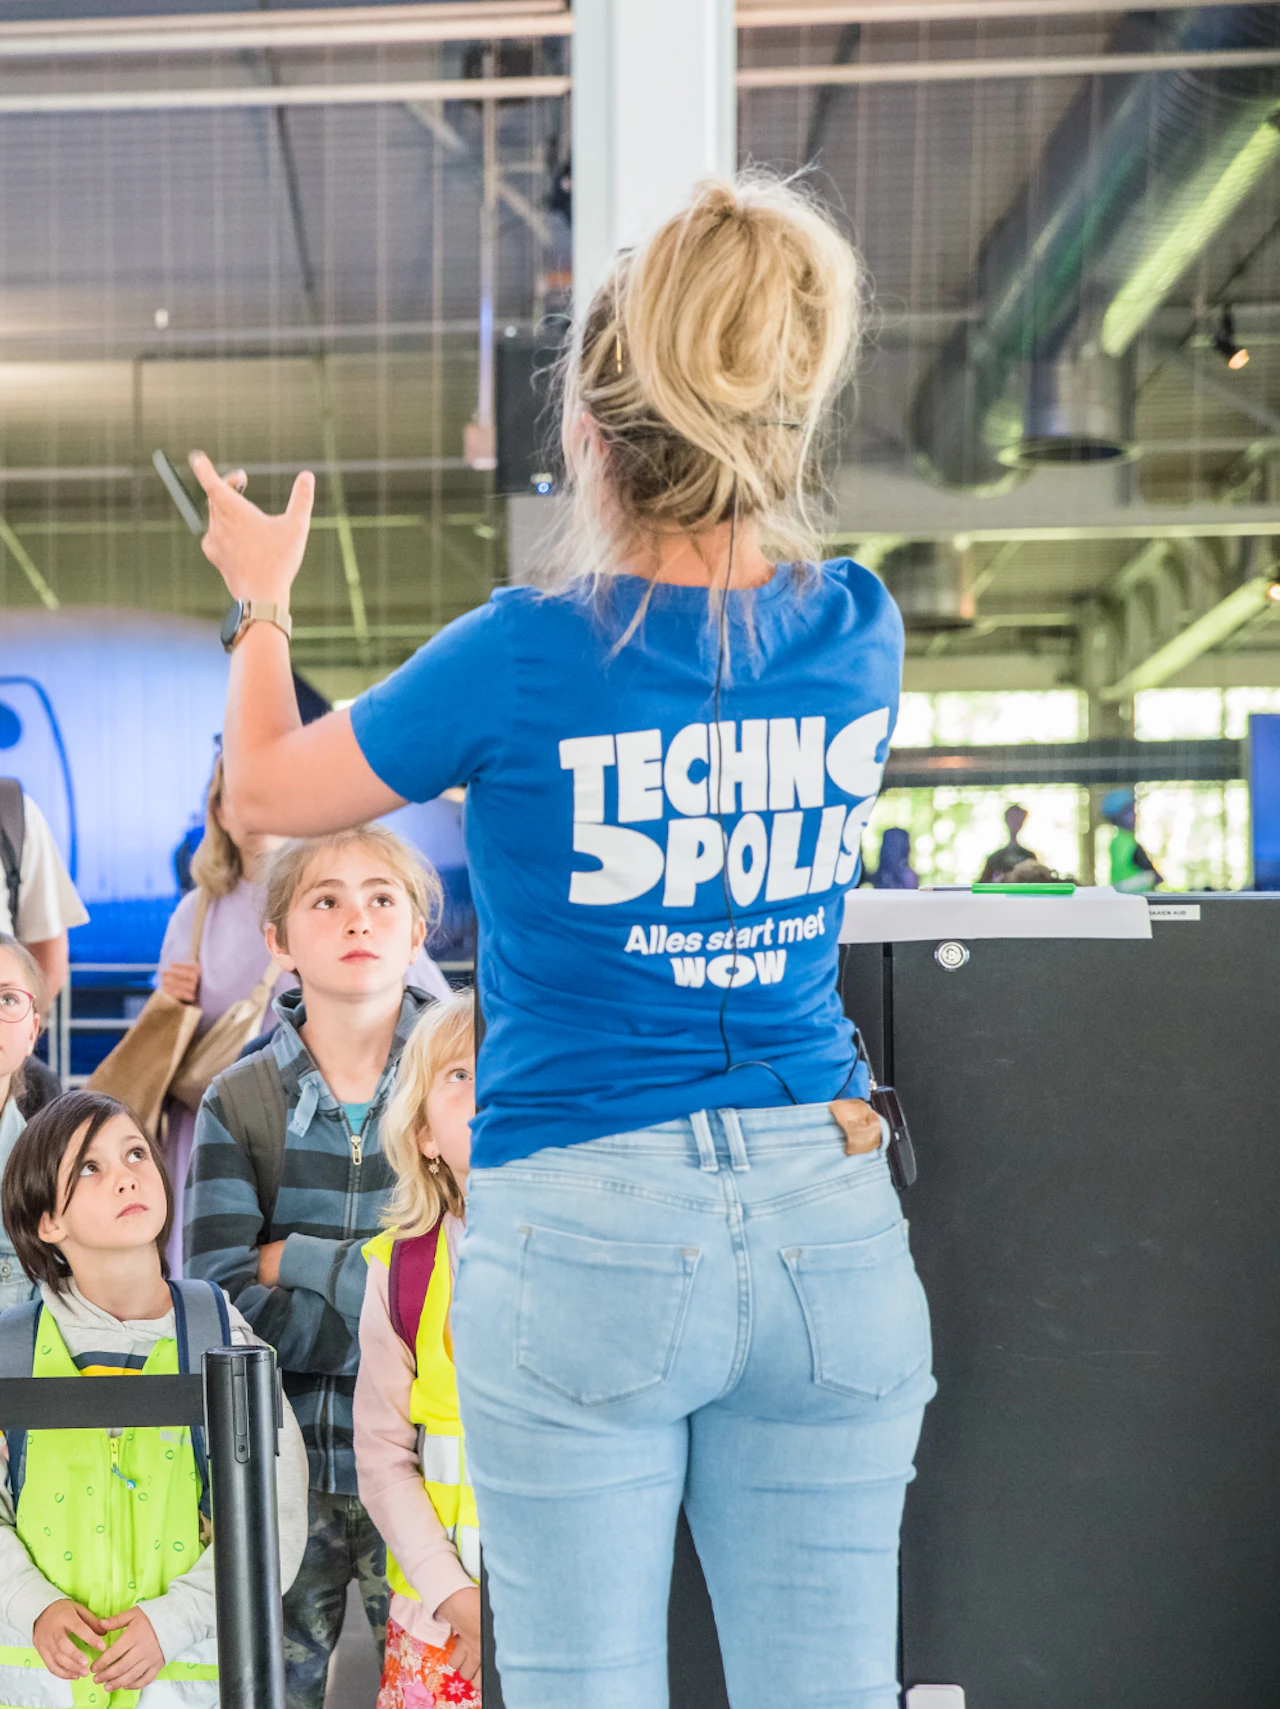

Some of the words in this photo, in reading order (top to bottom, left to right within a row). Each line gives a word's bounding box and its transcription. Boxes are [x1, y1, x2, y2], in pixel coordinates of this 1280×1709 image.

[624, 924, 704, 956] Alles
[705, 917, 776, 951] start
[777, 905, 826, 945] met
[669, 949, 788, 989] WOW
